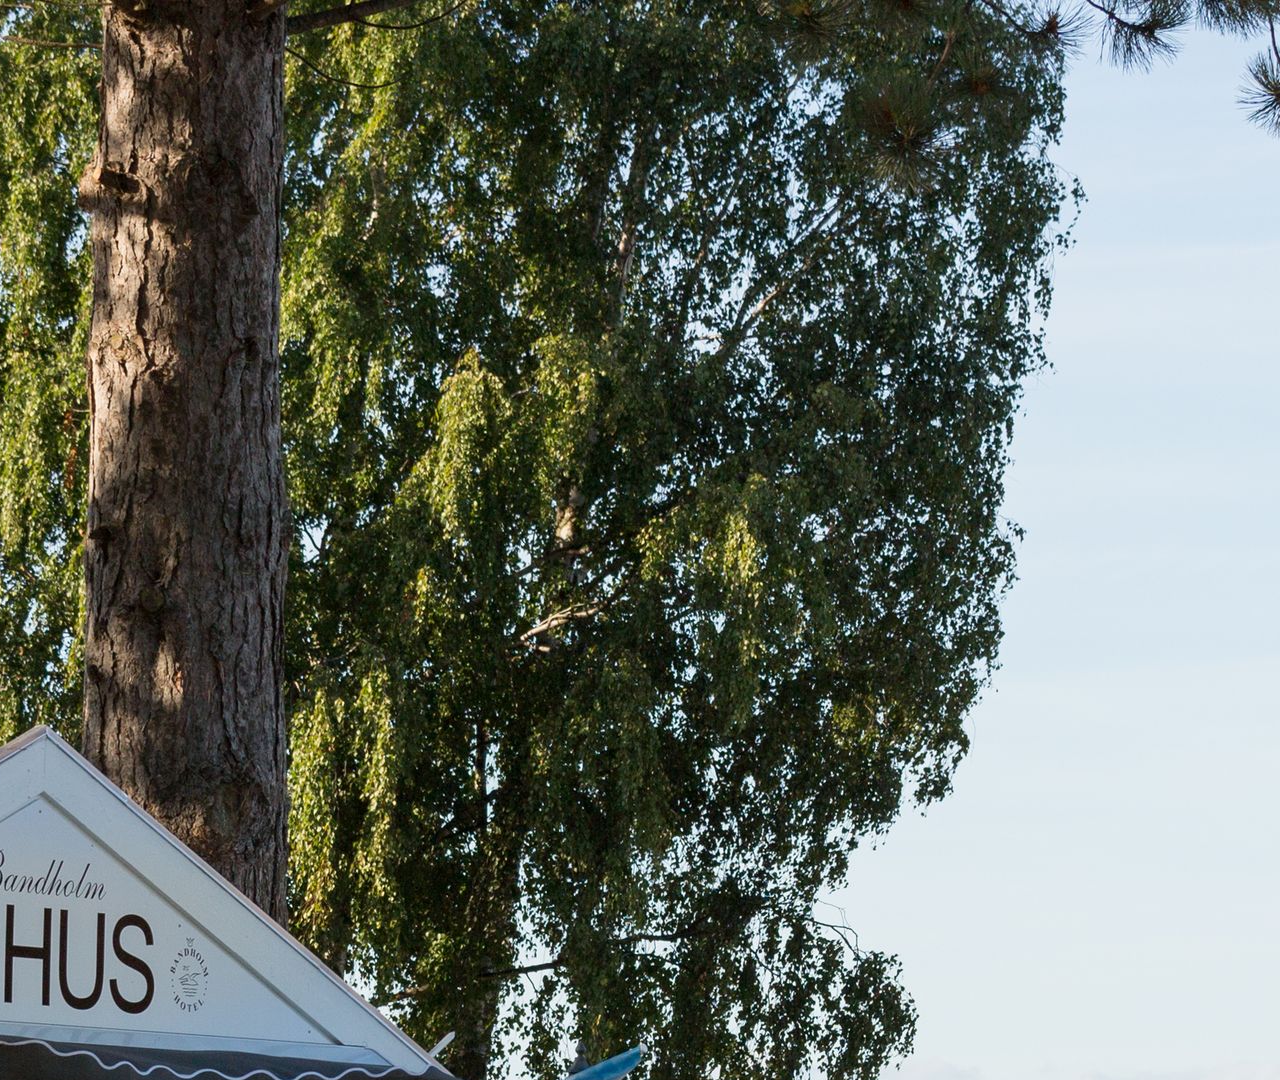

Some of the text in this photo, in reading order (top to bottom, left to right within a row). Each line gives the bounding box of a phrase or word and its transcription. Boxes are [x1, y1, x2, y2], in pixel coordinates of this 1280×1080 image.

[3, 904, 155, 1014] HUS
[170, 947, 209, 979] BANDHOLM
[174, 998, 205, 1014] HOTEL
